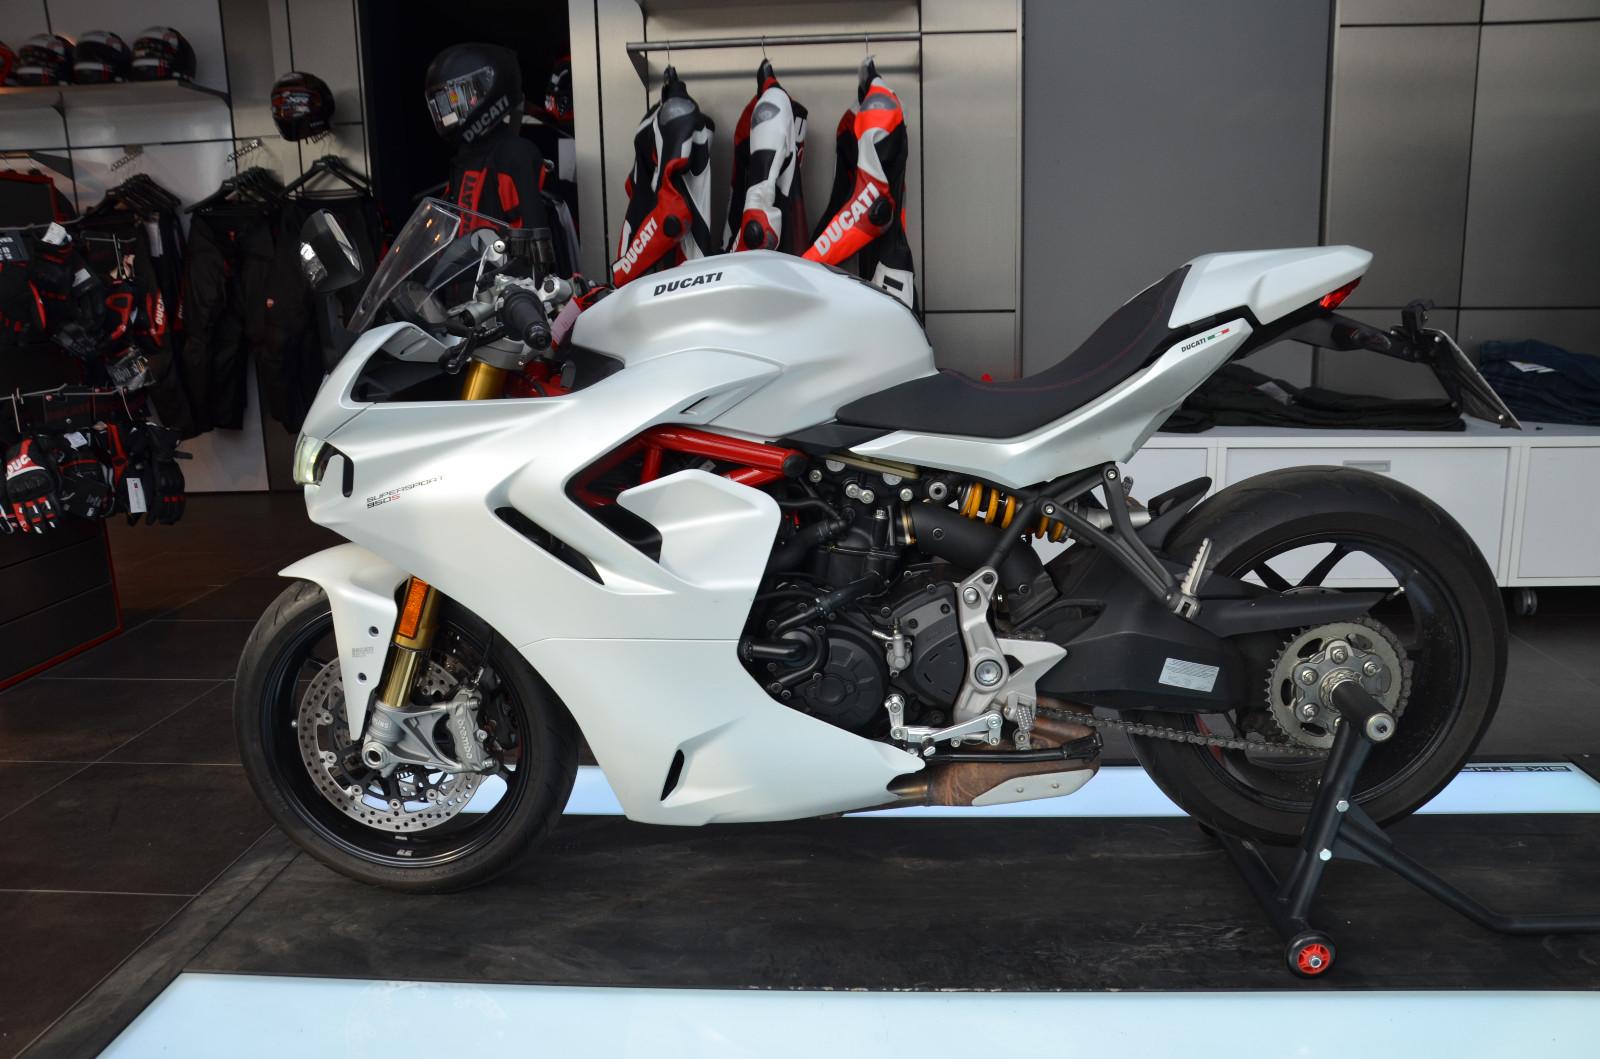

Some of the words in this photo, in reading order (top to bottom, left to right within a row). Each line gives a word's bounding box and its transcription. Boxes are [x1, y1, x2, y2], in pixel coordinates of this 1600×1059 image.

[463, 95, 510, 143] DUCATI
[814, 182, 881, 256] DUCATI
[621, 216, 658, 275] DUCATI
[653, 271, 723, 297] DUCATI
[1181, 337, 1207, 353] DUCATI
[366, 494, 401, 509] 950S
[457, 719, 473, 760] brembo
